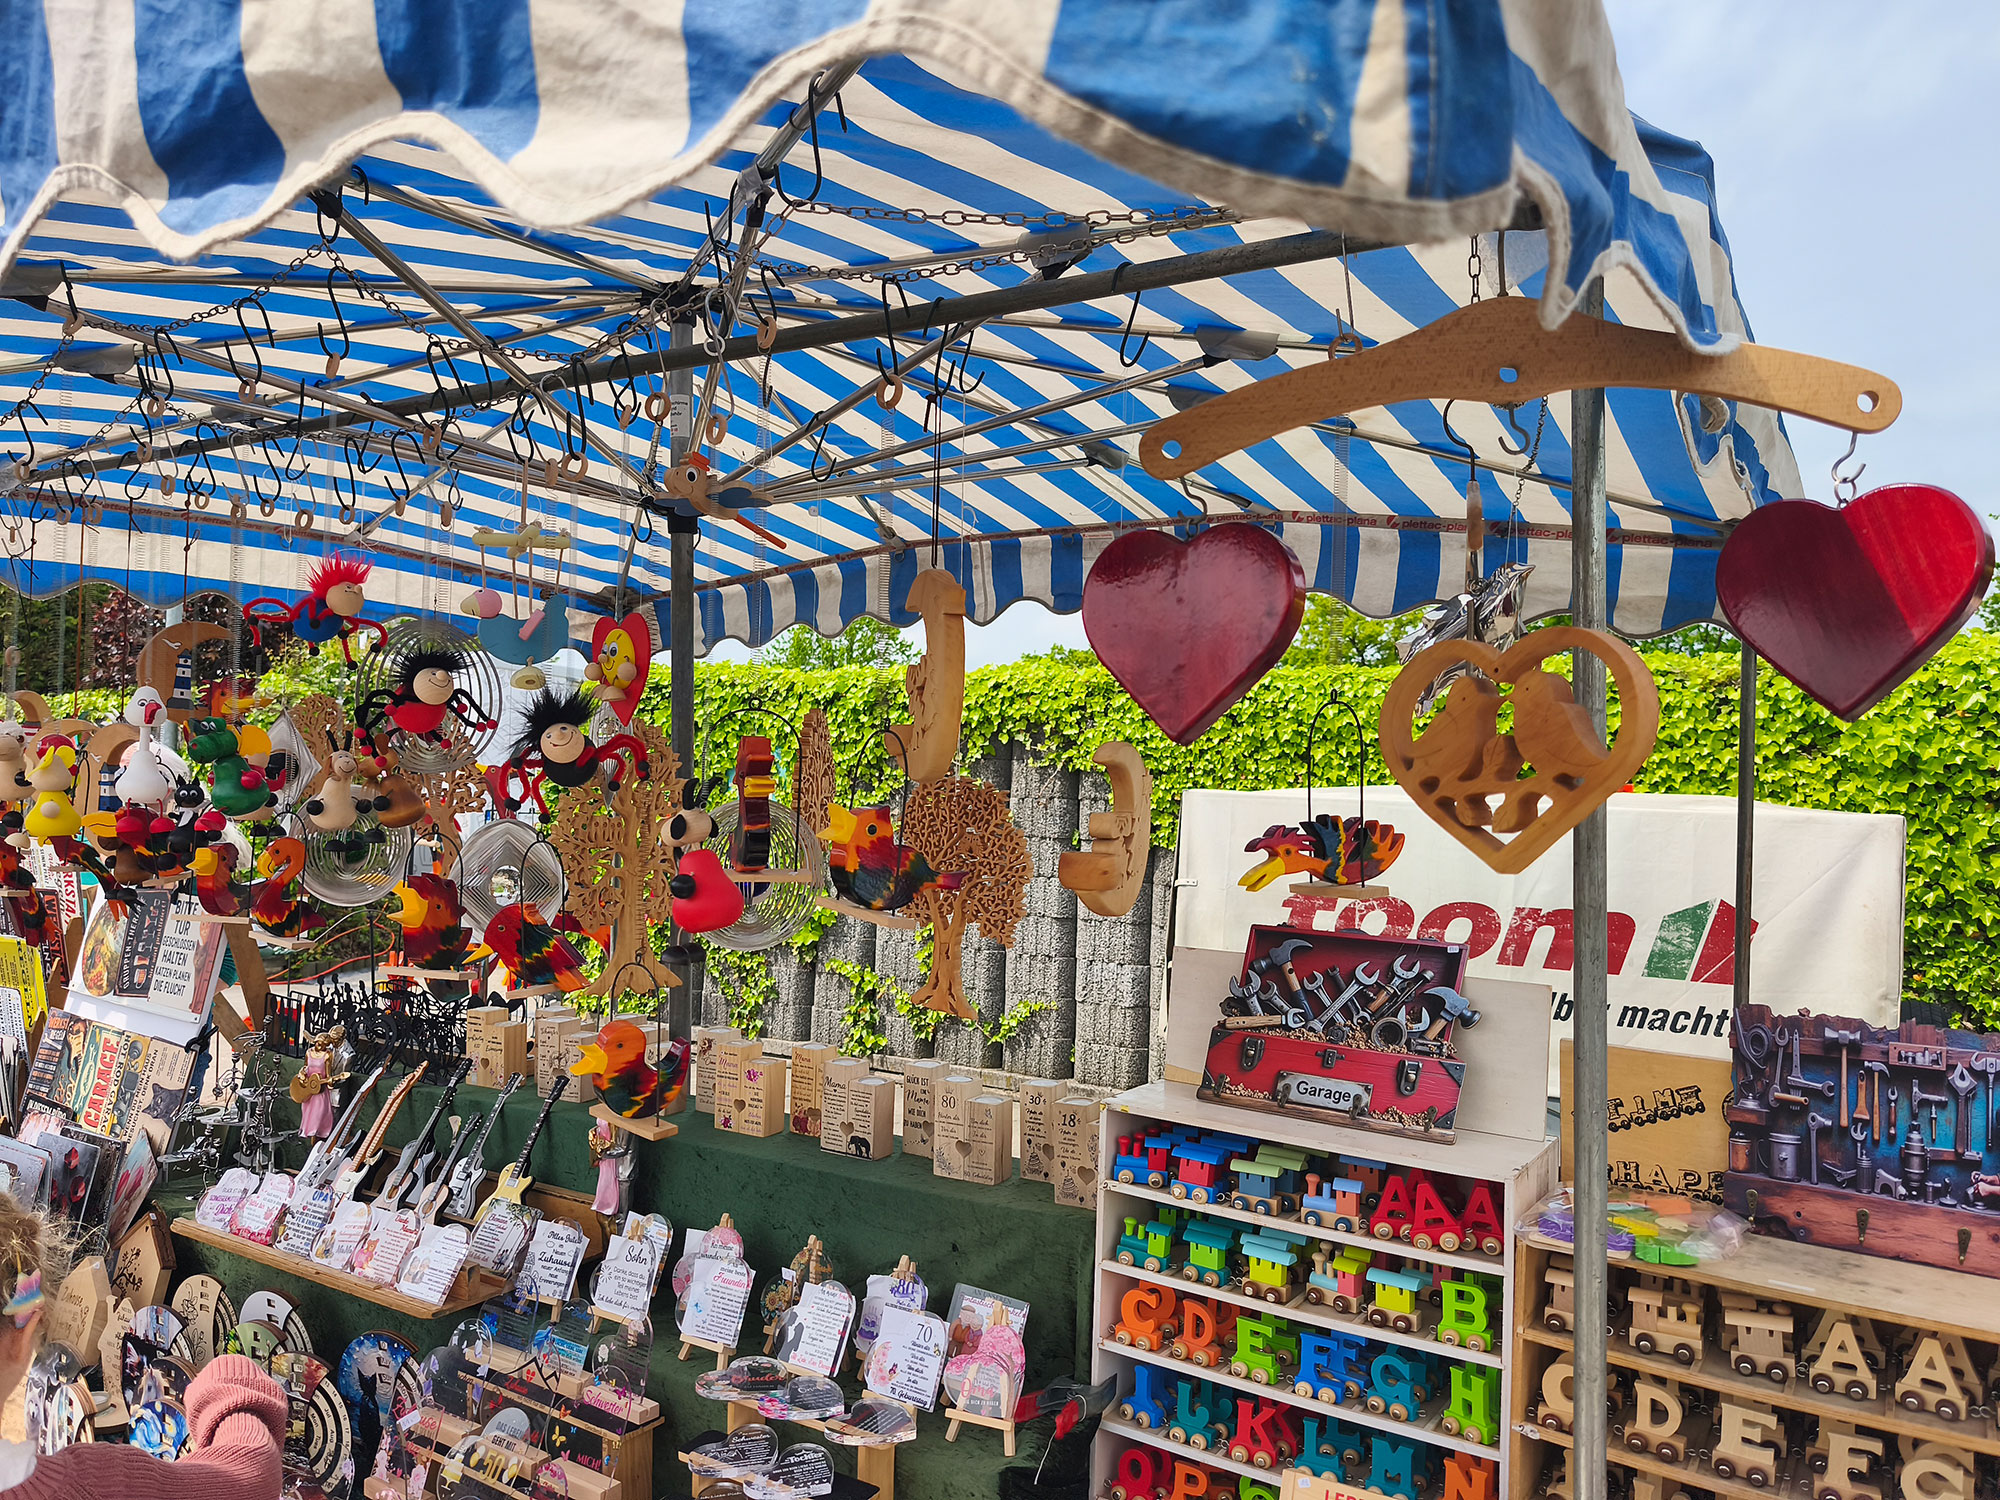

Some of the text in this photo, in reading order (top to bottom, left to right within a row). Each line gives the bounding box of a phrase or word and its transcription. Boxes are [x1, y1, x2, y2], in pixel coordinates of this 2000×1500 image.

[1622, 532, 1713, 548] plettac-plana
[162, 935, 195, 951] GESCHLOSSEN
[161, 950, 188, 967] HALTEN
[155, 966, 191, 982] KATZEN PLANEN
[153, 979, 186, 997] DIE FLUCHT
[121, 1034, 131, 1060] HOT
[113, 1062, 125, 1087] ROD
[141, 1074, 151, 1097] DENK
[148, 1049, 159, 1073] DRAN
[906, 1074, 929, 1087] GLÜCK IST
[84, 1037, 121, 1129] GARAGE
[824, 1076, 847, 1090] Mama
[123, 1053, 152, 1137] WENN DU MEIN HAUS
[1028, 1094, 1041, 1106] 30
[1296, 1080, 1352, 1104] Garage
[941, 1094, 956, 1110] 80
[917, 1109, 926, 1118] DICH
[1061, 1113, 1076, 1128] 18
[312, 1190, 329, 1203] OPA
[625, 1245, 647, 1265] Sohn
[628, 1270, 639, 1279] dass
[720, 1266, 734, 1274] meine
[713, 1271, 747, 1289] Freundin
[896, 1278, 915, 1296] 80
[613, 1289, 629, 1299] Lebens
[624, 1284, 640, 1294] meines
[916, 1323, 933, 1343] 70
[961, 1377, 995, 1398] Oma
[582, 1389, 624, 1415] Schwester
[310, 1412, 319, 1428] Mon
[323, 1408, 331, 1420] Jul
[495, 1421, 507, 1434] DAS
[491, 1434, 517, 1453] GEHT MIT
[787, 1451, 825, 1464] Tochter
[479, 1450, 506, 1485] 50
